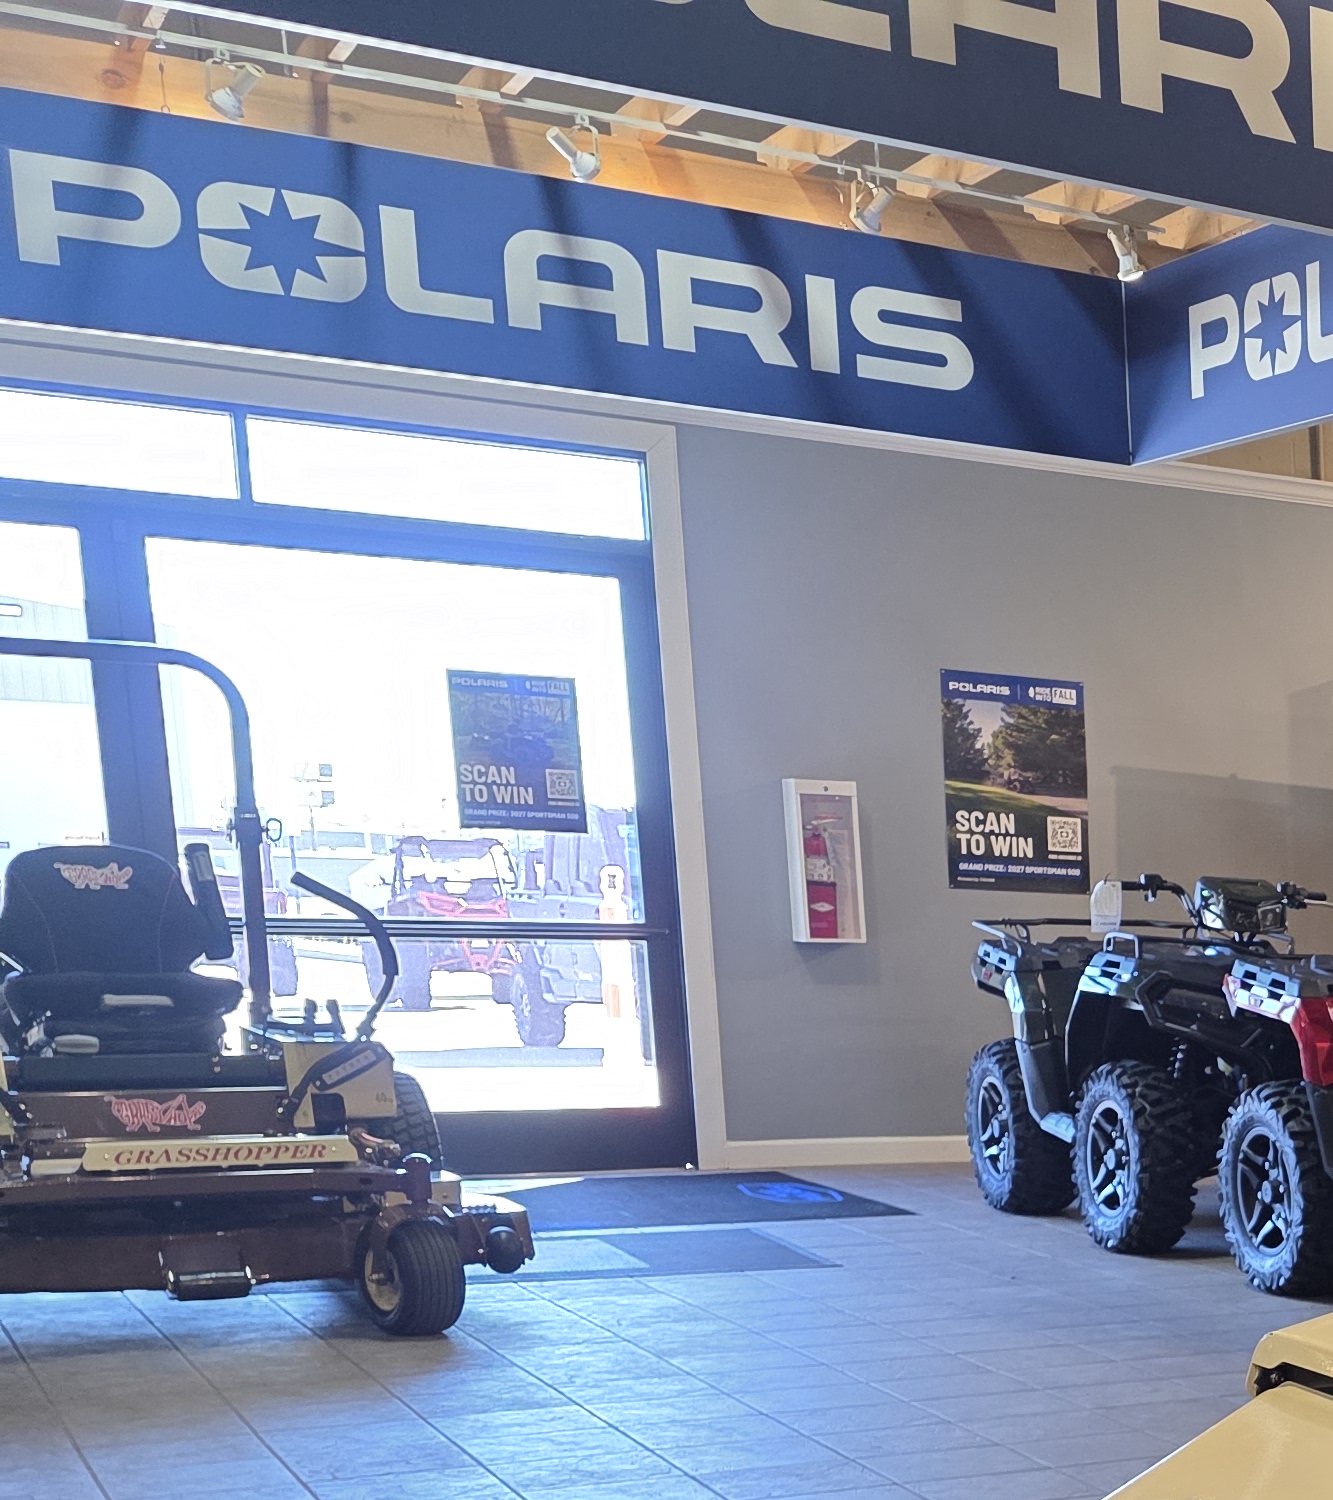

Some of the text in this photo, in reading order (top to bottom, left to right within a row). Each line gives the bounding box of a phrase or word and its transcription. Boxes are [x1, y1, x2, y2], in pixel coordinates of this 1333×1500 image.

[9, 148, 974, 391] POLARIS
[451, 677, 509, 688] POLARIS
[949, 682, 1075, 701] POLARIS FALL
[459, 764, 516, 784] SCAN
[461, 784, 534, 805] TO WIN
[955, 810, 1015, 834] SCAN
[956, 833, 1034, 859] TO WIN
[114, 1144, 327, 1166] GRASSHOPPER
